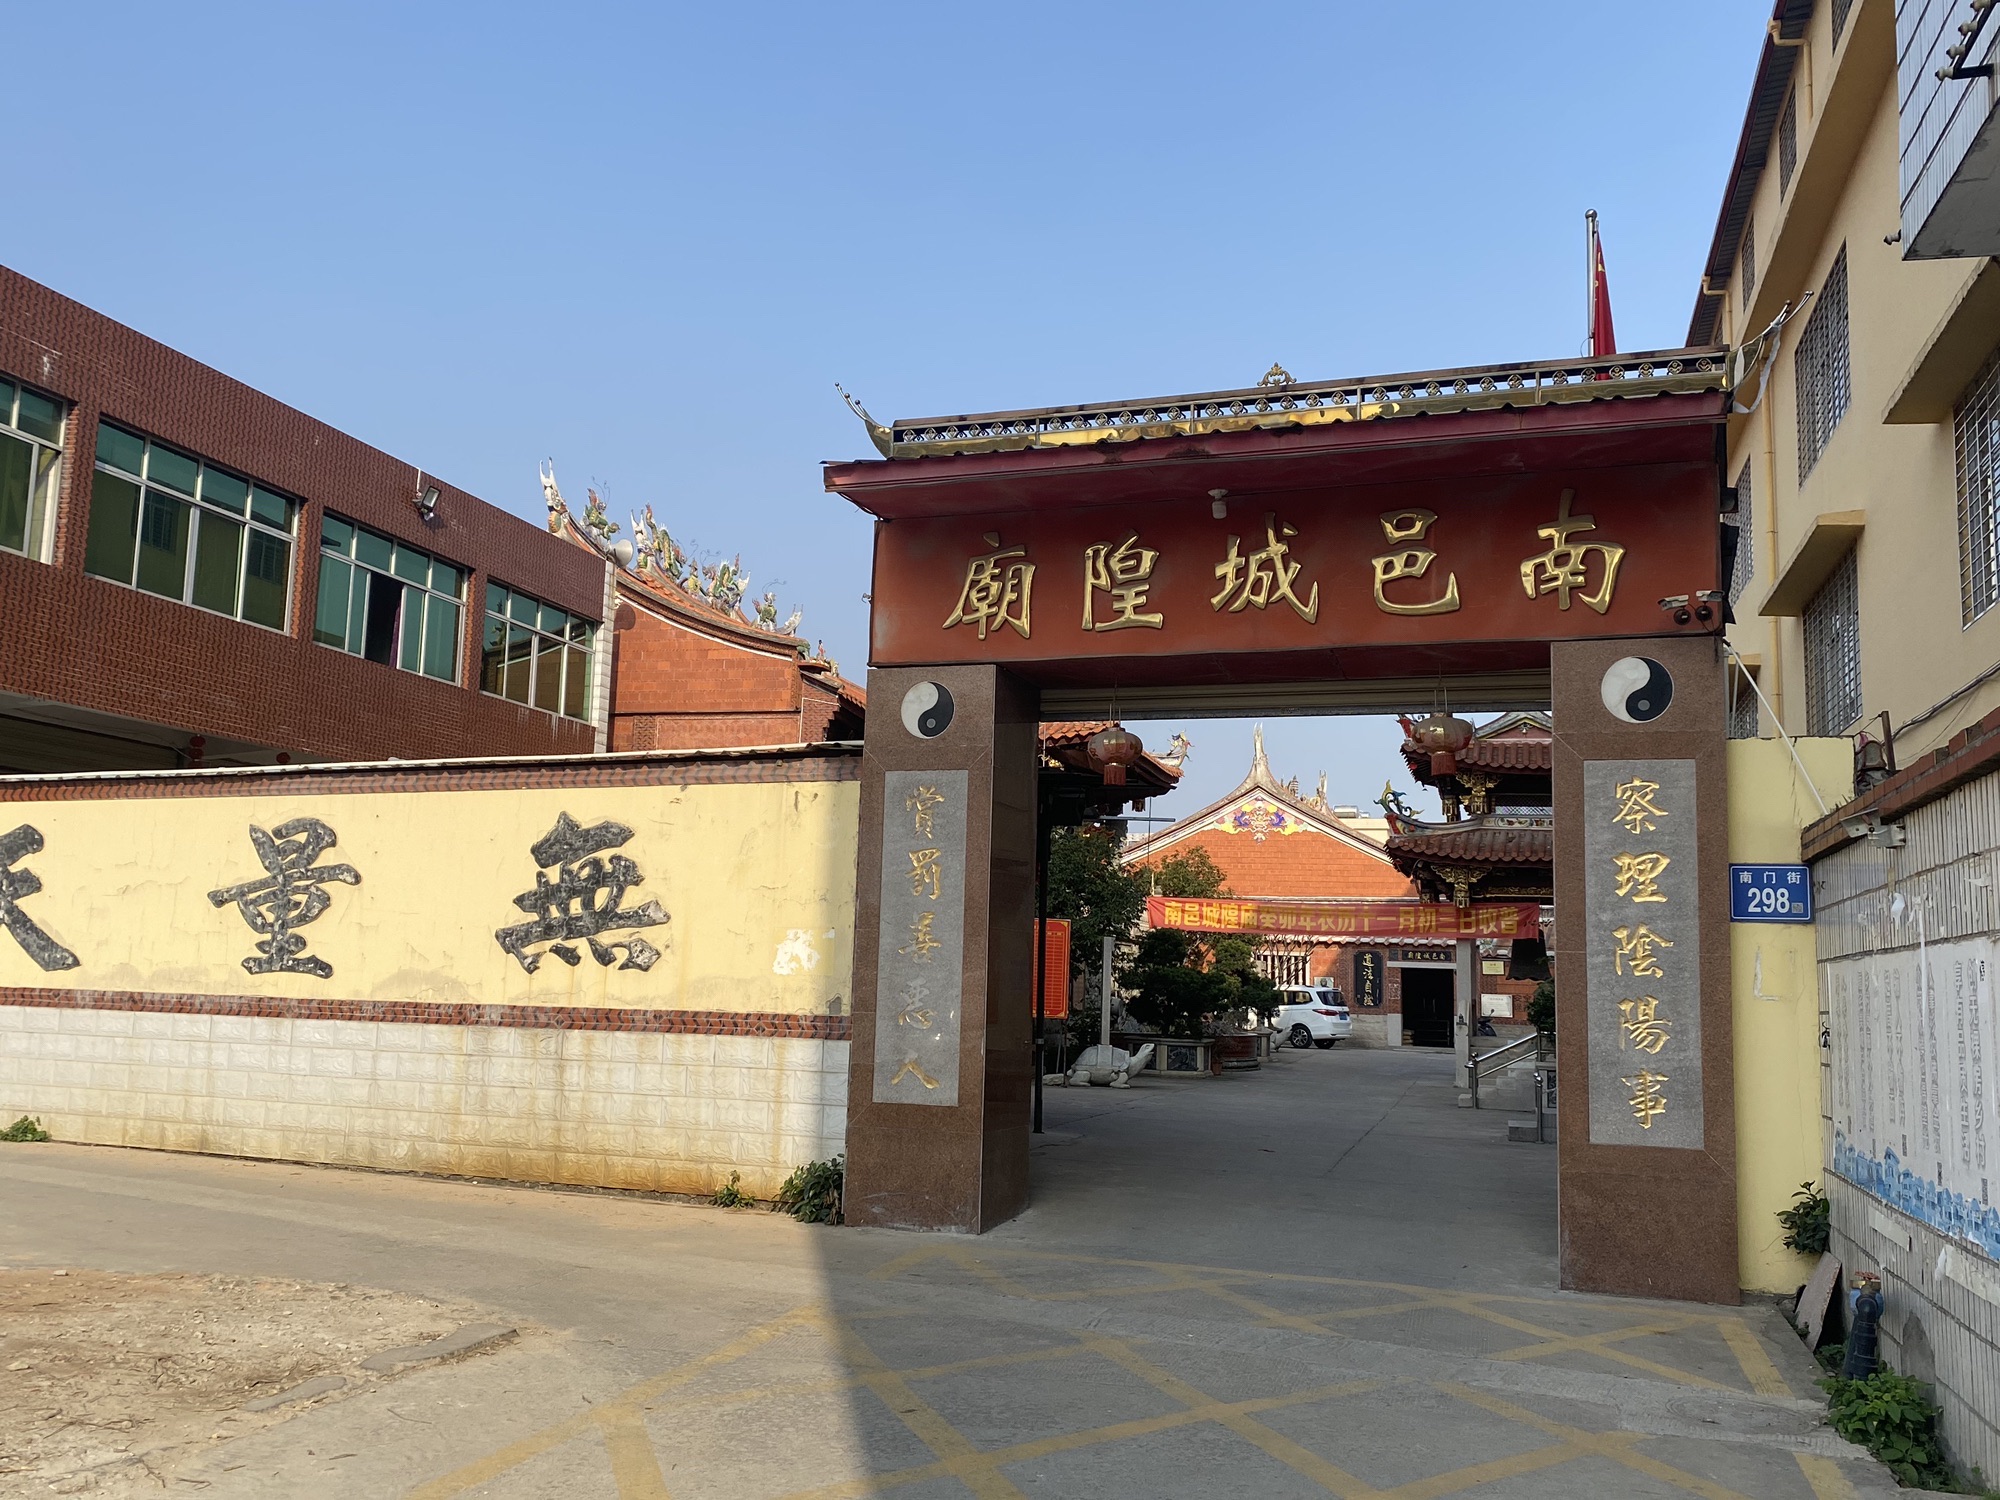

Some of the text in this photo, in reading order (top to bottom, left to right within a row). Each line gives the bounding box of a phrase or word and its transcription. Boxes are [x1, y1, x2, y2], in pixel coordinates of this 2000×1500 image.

[942, 488, 1627, 641] 南邑城隍廟
[1739, 870, 1802, 885] 南门街
[1747, 887, 1791, 914] 298
[1611, 776, 1675, 1130] 察理陰陽事
